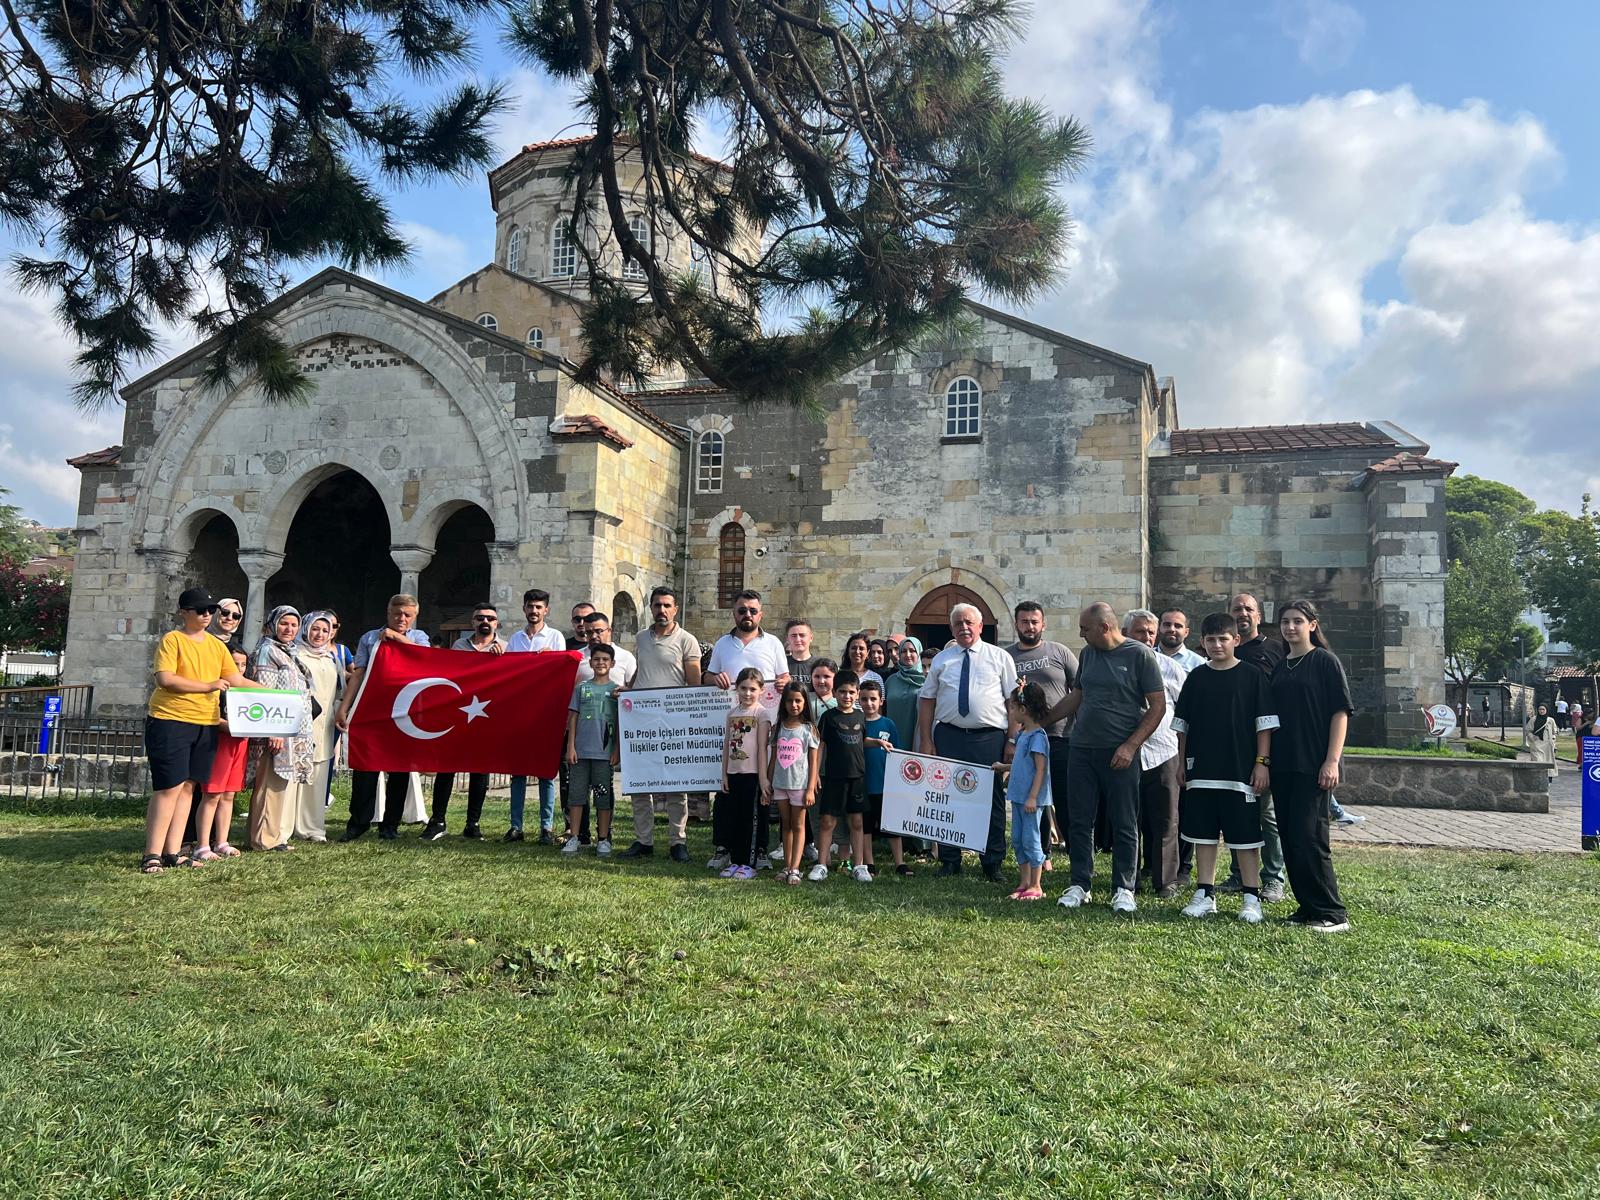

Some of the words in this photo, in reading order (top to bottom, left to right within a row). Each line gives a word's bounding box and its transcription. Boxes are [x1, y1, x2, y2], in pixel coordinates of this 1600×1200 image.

[238, 702, 296, 722] ROYAL
[625, 730, 634, 739] Bu
[637, 729, 657, 740] Proje
[659, 727, 686, 740] İçişleri
[689, 726, 726, 737] Bakanlığı
[630, 741, 659, 755] İlişkiler
[661, 740, 684, 751] Genel
[687, 738, 724, 751] Müdürlüğ
[665, 754, 723, 765] Desteklenmekt
[925, 790, 950, 805] ŞEHİT
[917, 805, 955, 824] AİLELERİ
[903, 820, 966, 844] KUCAKLAŞIYOR
